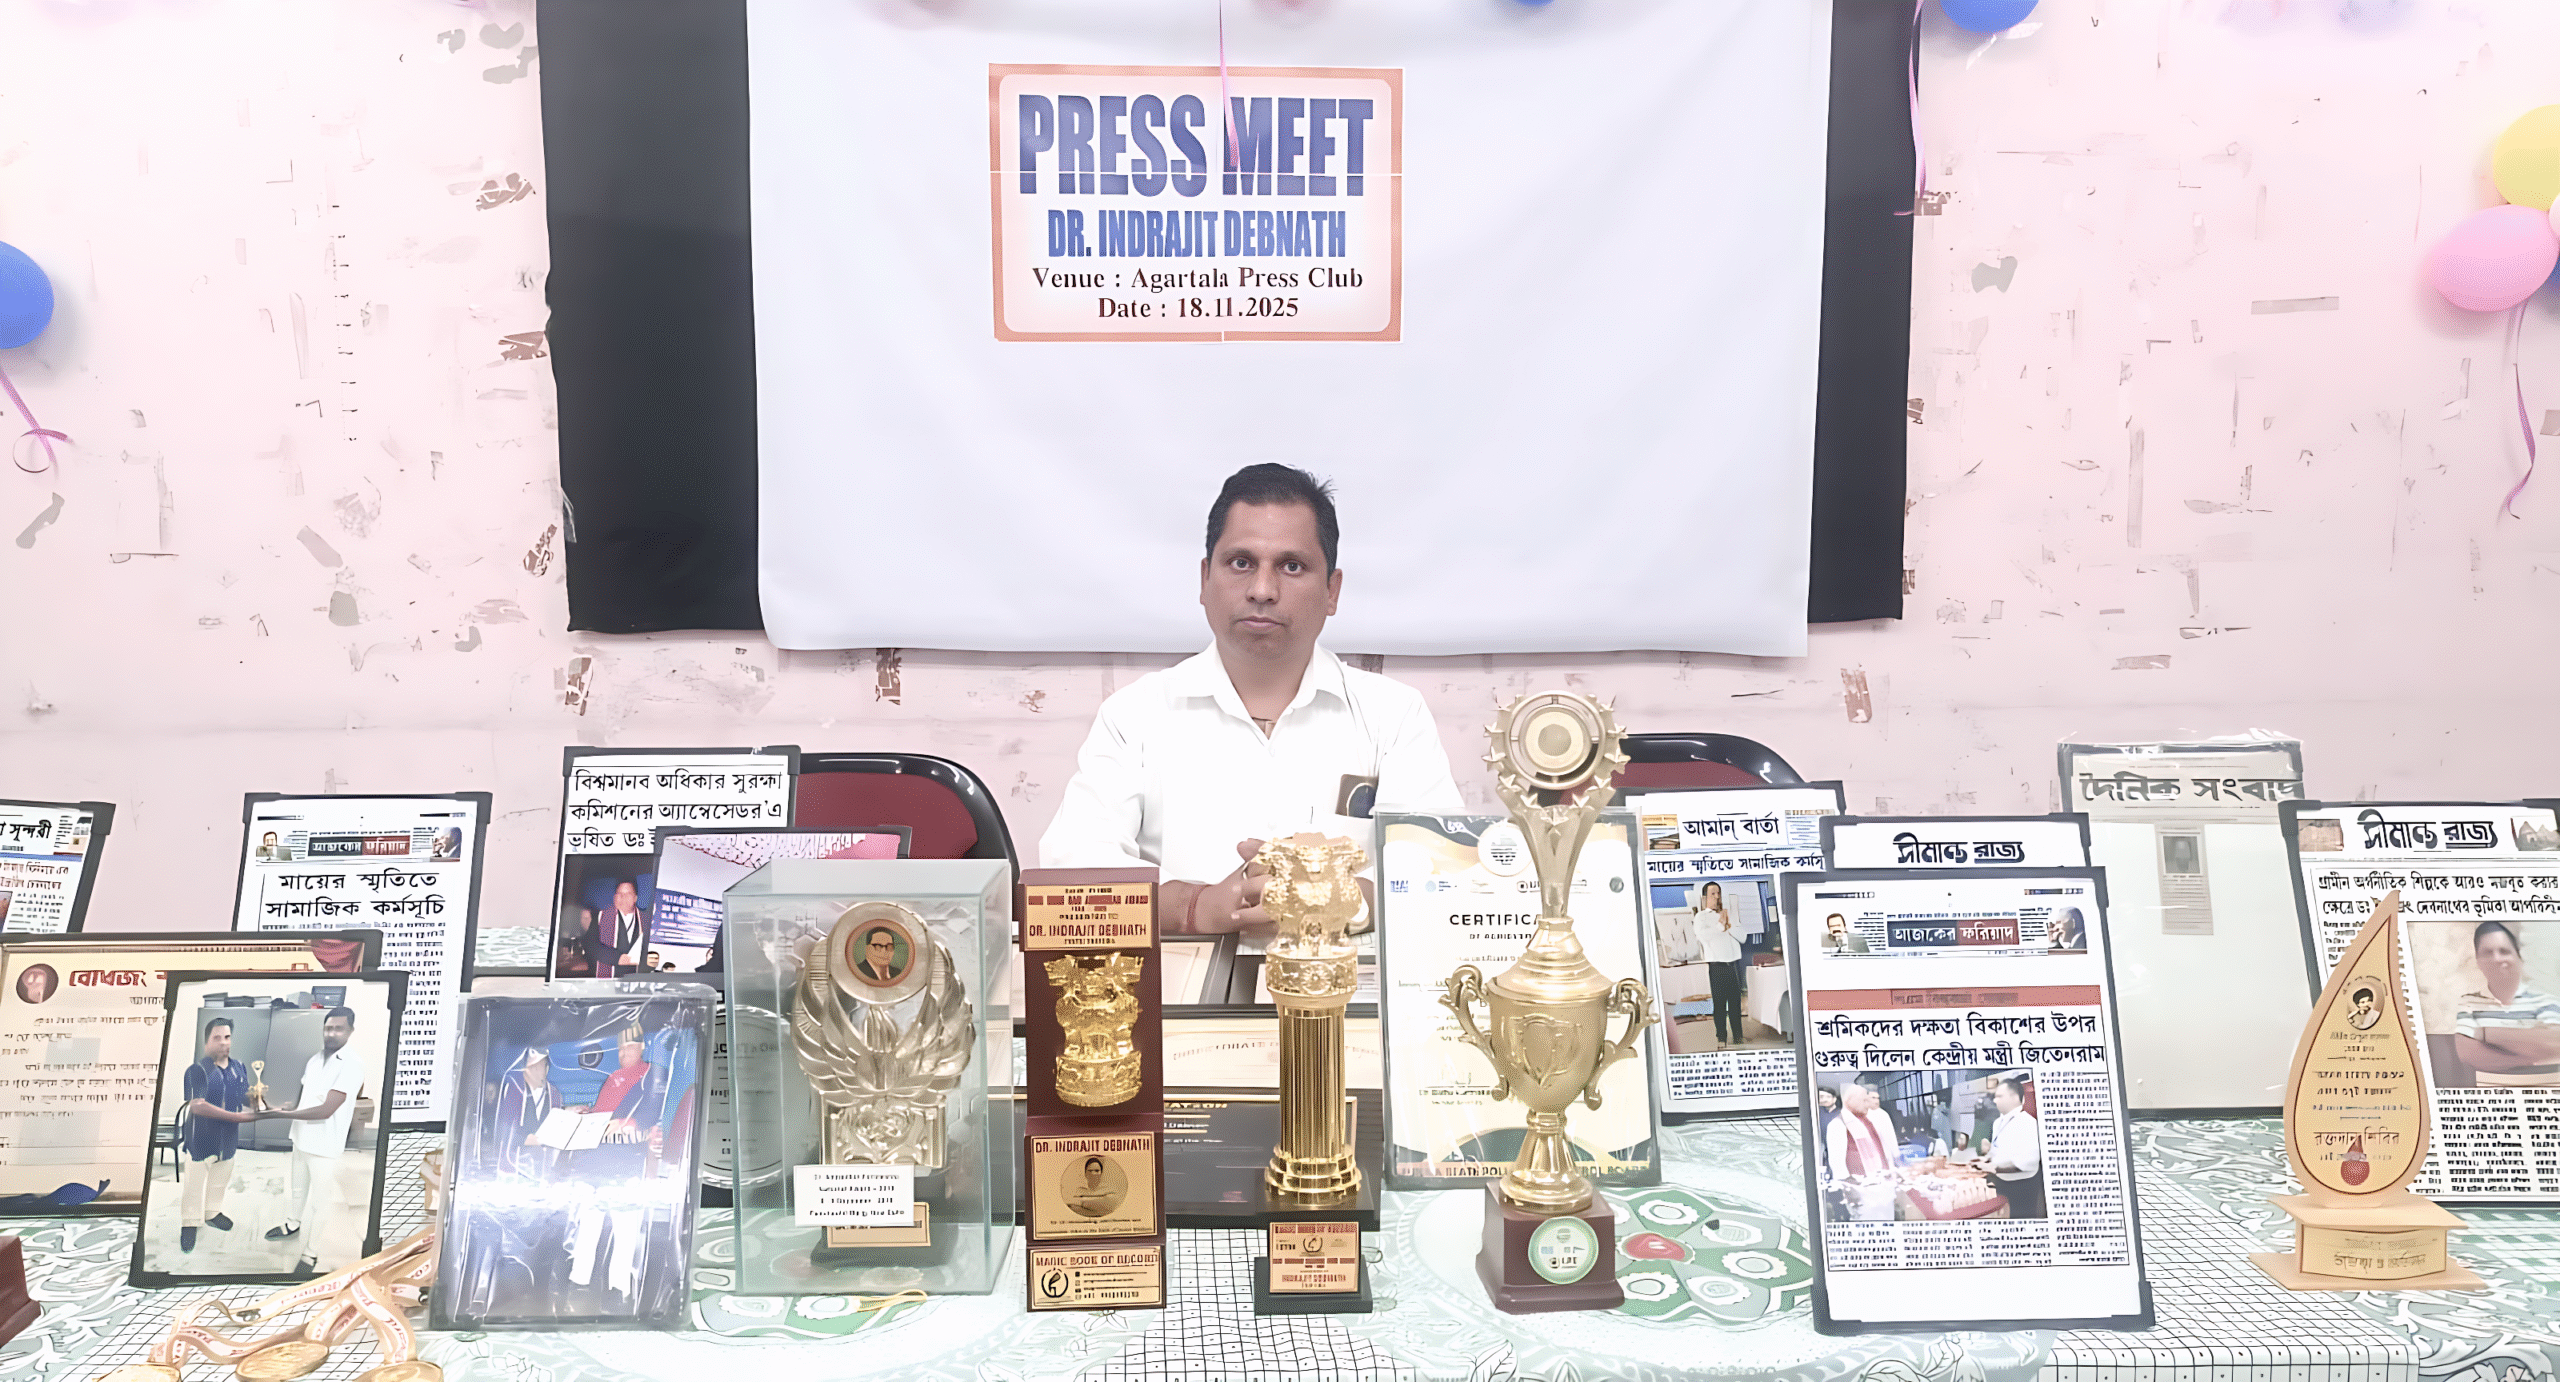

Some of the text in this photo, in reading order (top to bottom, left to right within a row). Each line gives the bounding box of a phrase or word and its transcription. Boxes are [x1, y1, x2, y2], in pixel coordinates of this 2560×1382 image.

[1018, 93, 1374, 198] PRESS MEET
[1047, 209, 1346, 258] DR. INDRAJIT DEBNATH
[1031, 267, 1105, 289] Venue
[1131, 267, 1229, 294] Agartala
[1238, 266, 1299, 288] Press
[1308, 267, 1363, 288] Club
[1098, 297, 1152, 319] Date
[1177, 296, 1299, 319] 18.11.2025
[656, 768, 725, 790] অধিকার
[732, 771, 782, 794] সুরক্ষা
[2078, 770, 2305, 801] দৈনিক সংবাদ
[568, 798, 653, 821] কমিশনের
[1740, 812, 1779, 835] বার্তা
[2356, 808, 2499, 850] সীমান্ত রাজ্য
[1892, 832, 2026, 864] সীমান্ত রাজ্য
[278, 867, 440, 893] মায়ের স্মৃতিতে
[265, 893, 446, 919] সামাজিক কর্মসূচি
[1814, 1010, 2096, 1038] শ্রমিকদের দক্ষতা বিকাশের উপর
[1814, 1040, 2105, 1069] গুরুত্ব দিলেন কেন্দ্রীয় মন্ত্রী জিতেনরাম
